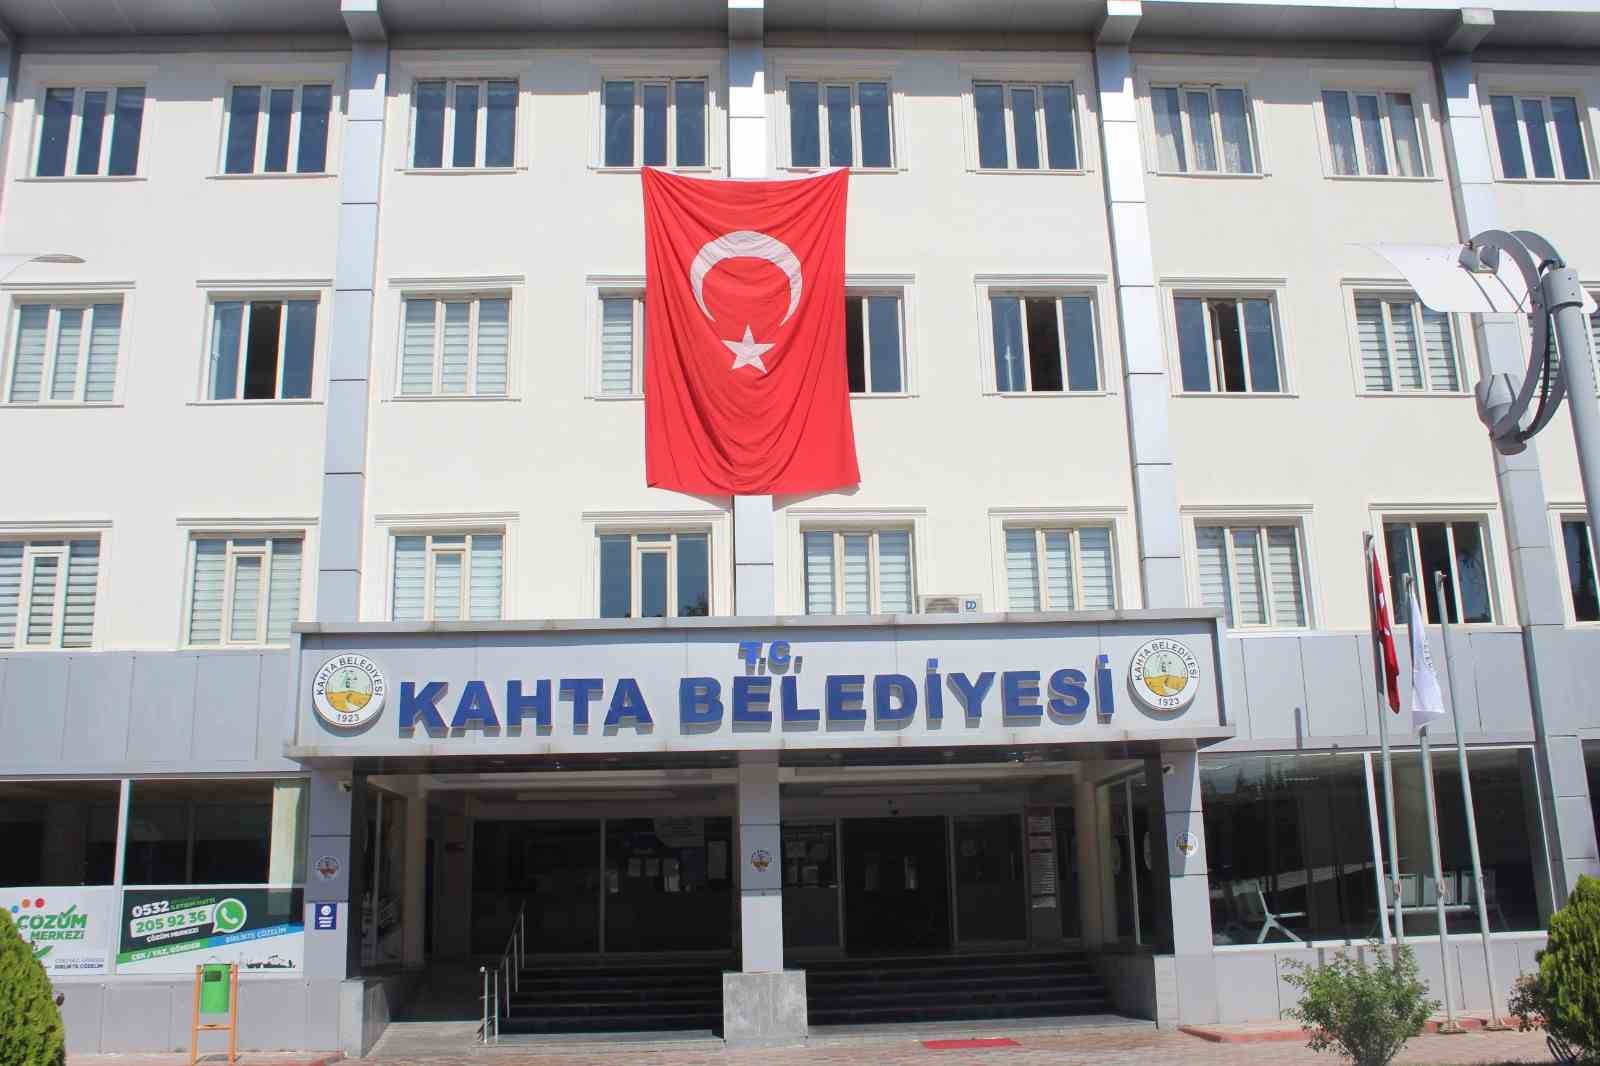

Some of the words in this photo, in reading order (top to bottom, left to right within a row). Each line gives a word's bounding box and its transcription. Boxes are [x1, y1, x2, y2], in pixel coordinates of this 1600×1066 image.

[316, 663, 338, 696] KAHTA
[400, 678, 655, 735] KAHTA
[680, 654, 1115, 733] BELEDİYESİ
[1159, 697, 1180, 706] 1923
[337, 713, 360, 723] 1923
[132, 900, 170, 918] 0532
[135, 918, 164, 934] 205
[167, 914, 185, 928] 92
[188, 910, 207, 924] 36
